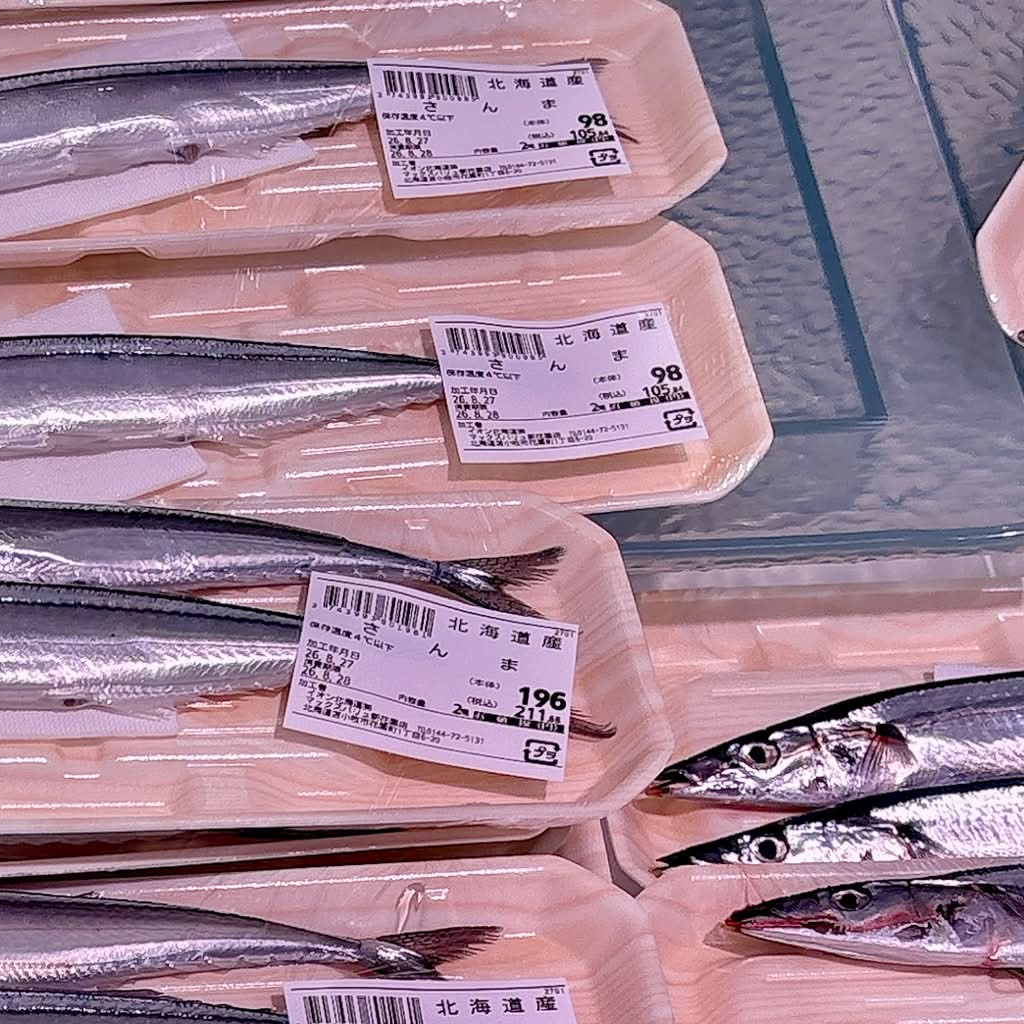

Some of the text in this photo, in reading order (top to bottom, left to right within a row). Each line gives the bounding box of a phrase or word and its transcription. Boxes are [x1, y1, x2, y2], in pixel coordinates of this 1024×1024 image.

[578, 113, 608, 128] 98
[651, 365, 683, 384] 98
[448, 616, 563, 650] 北海道産
[519, 686, 567, 711] 196
[436, 996, 558, 1016] 北海道産
